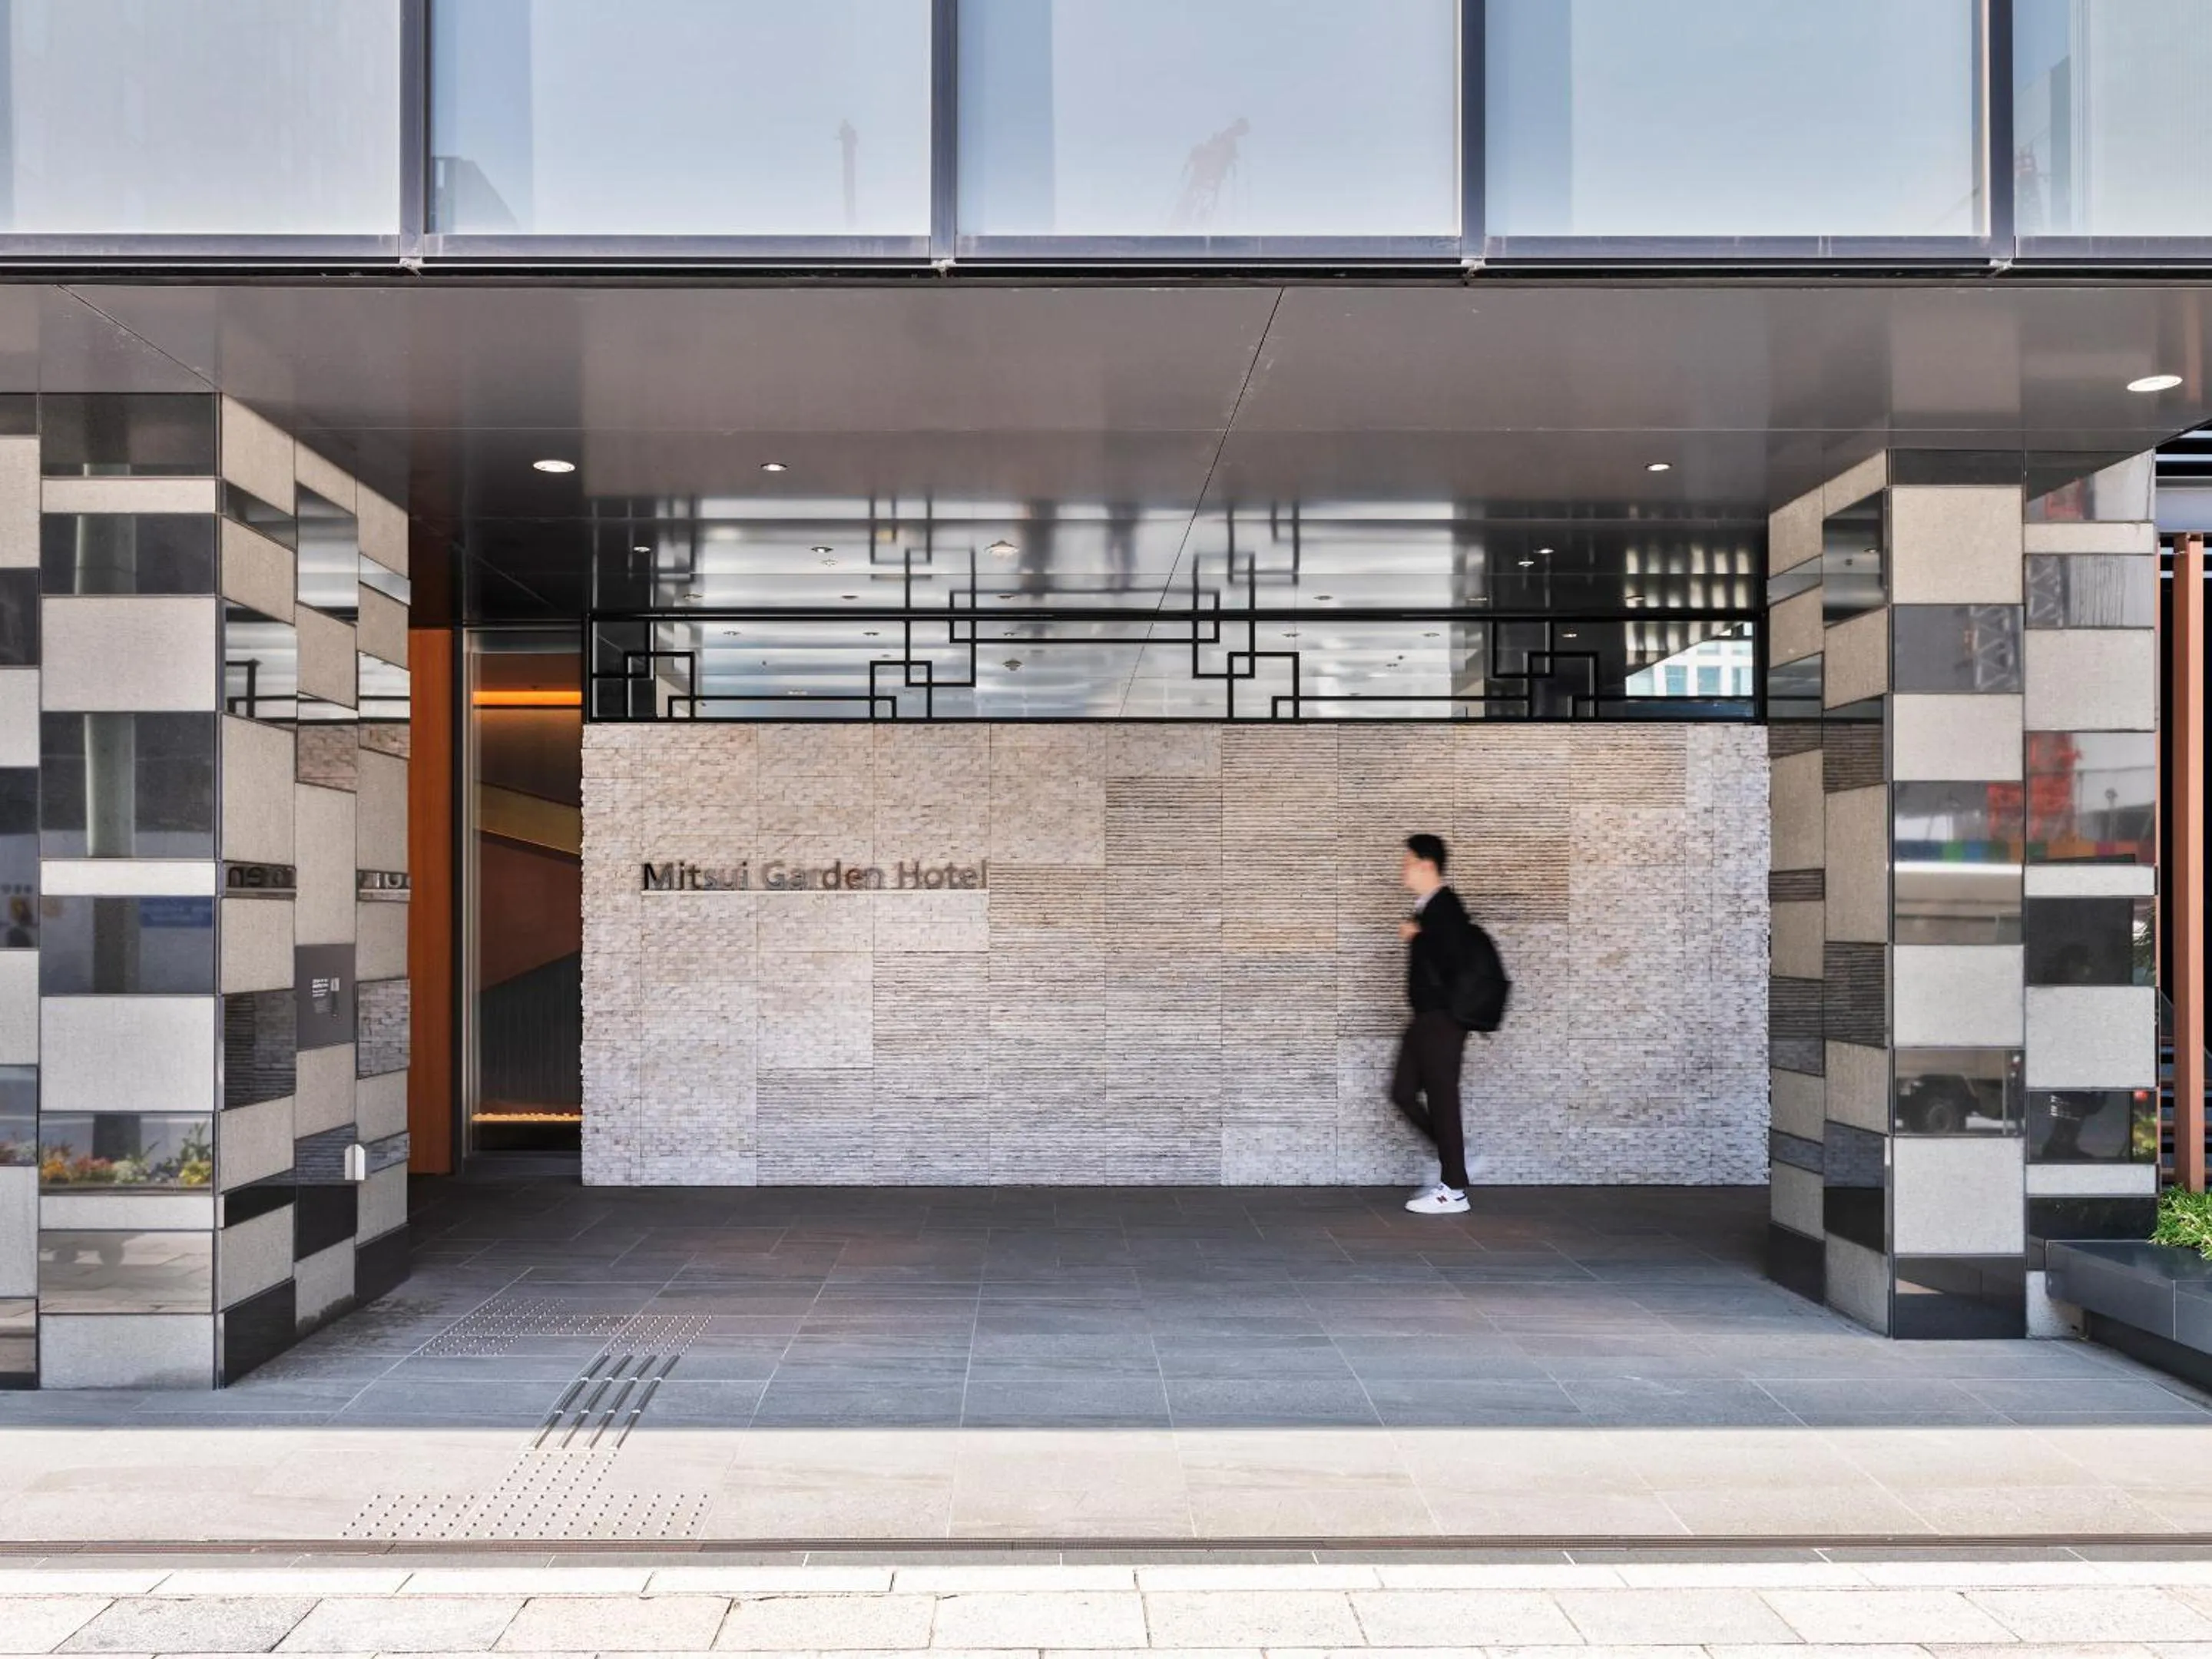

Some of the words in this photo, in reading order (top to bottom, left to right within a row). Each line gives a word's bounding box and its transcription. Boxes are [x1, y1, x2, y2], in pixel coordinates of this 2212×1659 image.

[643, 862, 748, 890] Mitsui
[763, 859, 882, 890] Garden
[897, 859, 988, 889] Hotel
